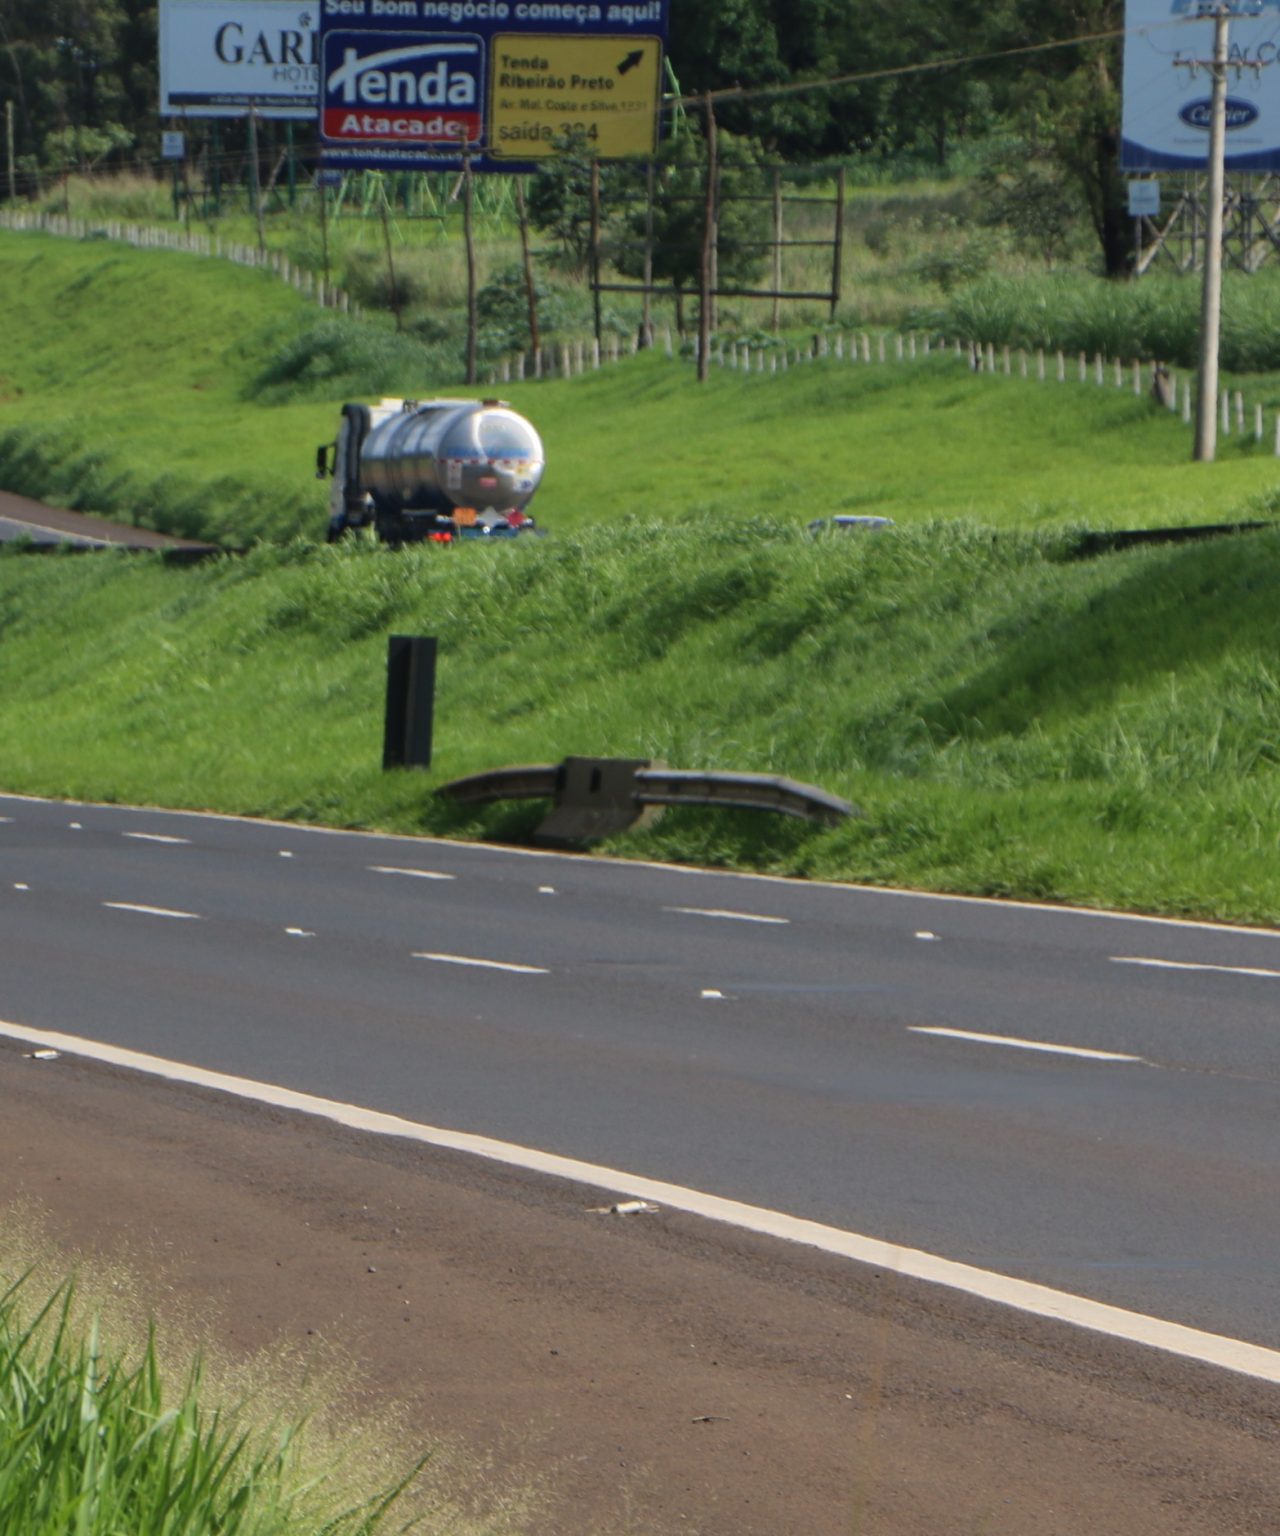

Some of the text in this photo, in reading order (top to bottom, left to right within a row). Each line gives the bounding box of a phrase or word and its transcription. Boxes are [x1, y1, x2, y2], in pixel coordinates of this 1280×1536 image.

[325, 0, 661, 24] Seu bom negócio começa aqui!
[501, 55, 549, 70] Tenda
[499, 73, 614, 90] Ribeirão Preto
[545, 100, 578, 112] Costa
[340, 114, 466, 137] Atacado
[499, 121, 553, 141] saída
